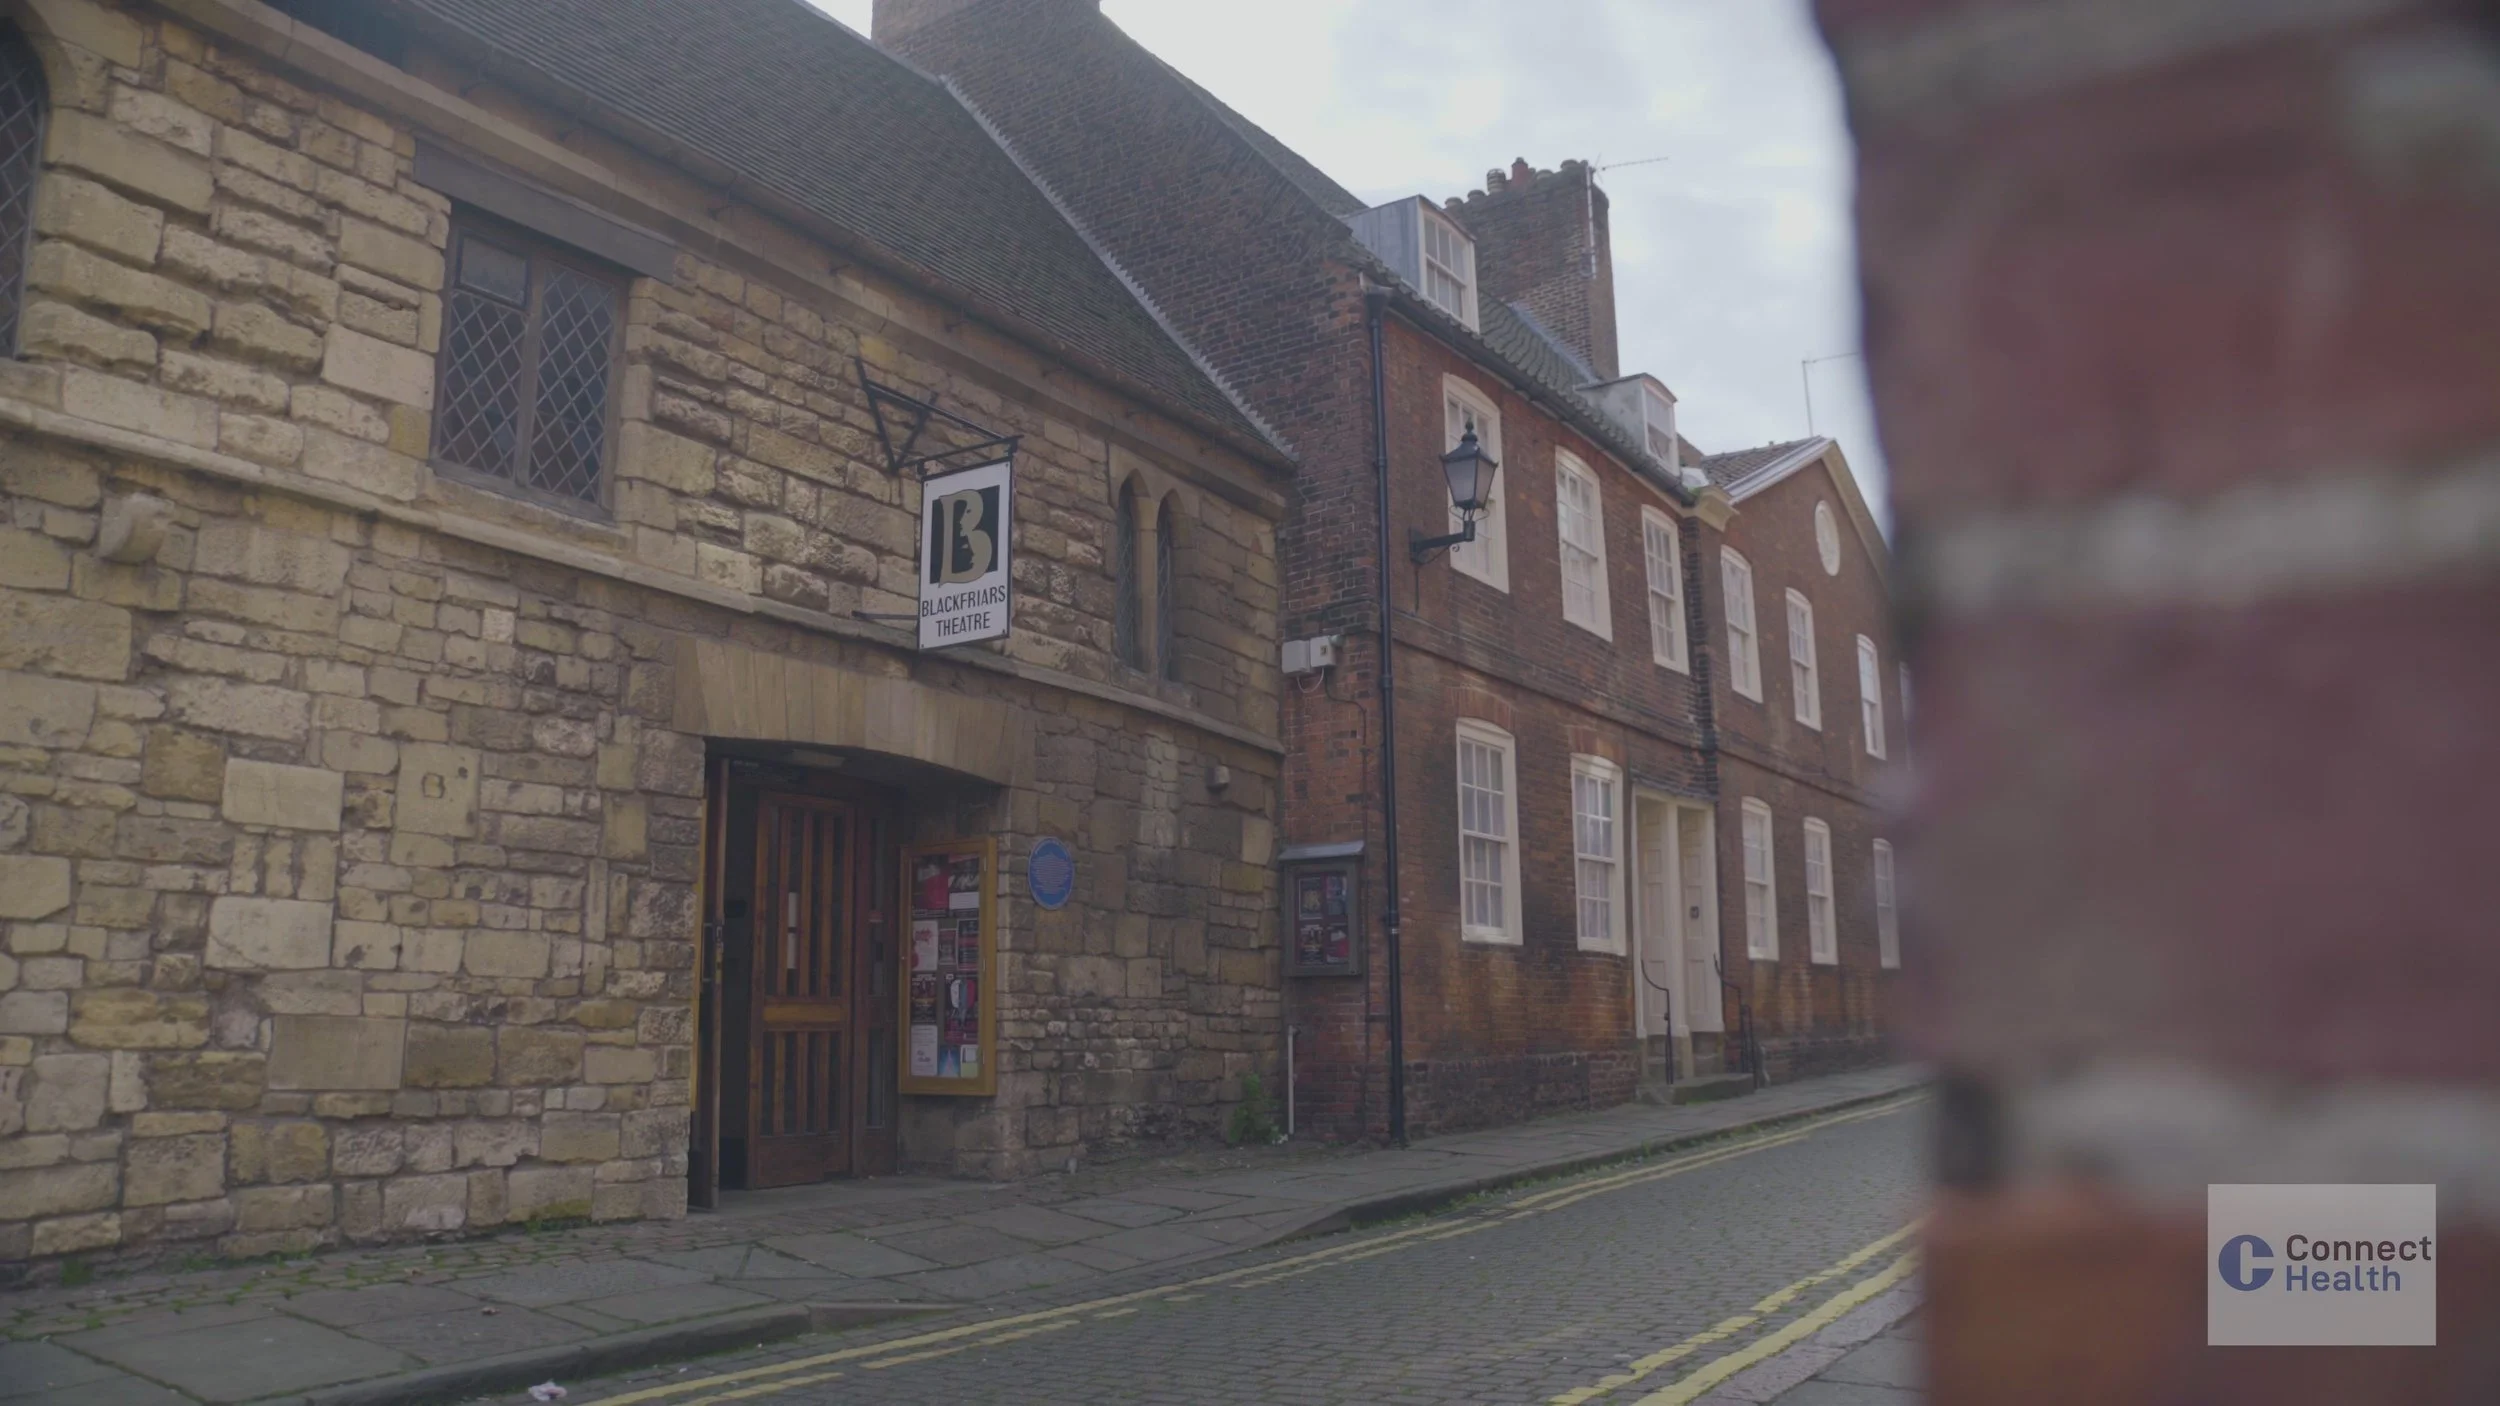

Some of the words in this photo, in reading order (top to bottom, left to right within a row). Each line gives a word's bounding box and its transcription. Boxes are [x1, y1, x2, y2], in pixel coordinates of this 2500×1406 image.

[939, 490, 992, 588] B
[922, 586, 1006, 617] BLACKFRIARS
[936, 612, 990, 637] THEATRE
